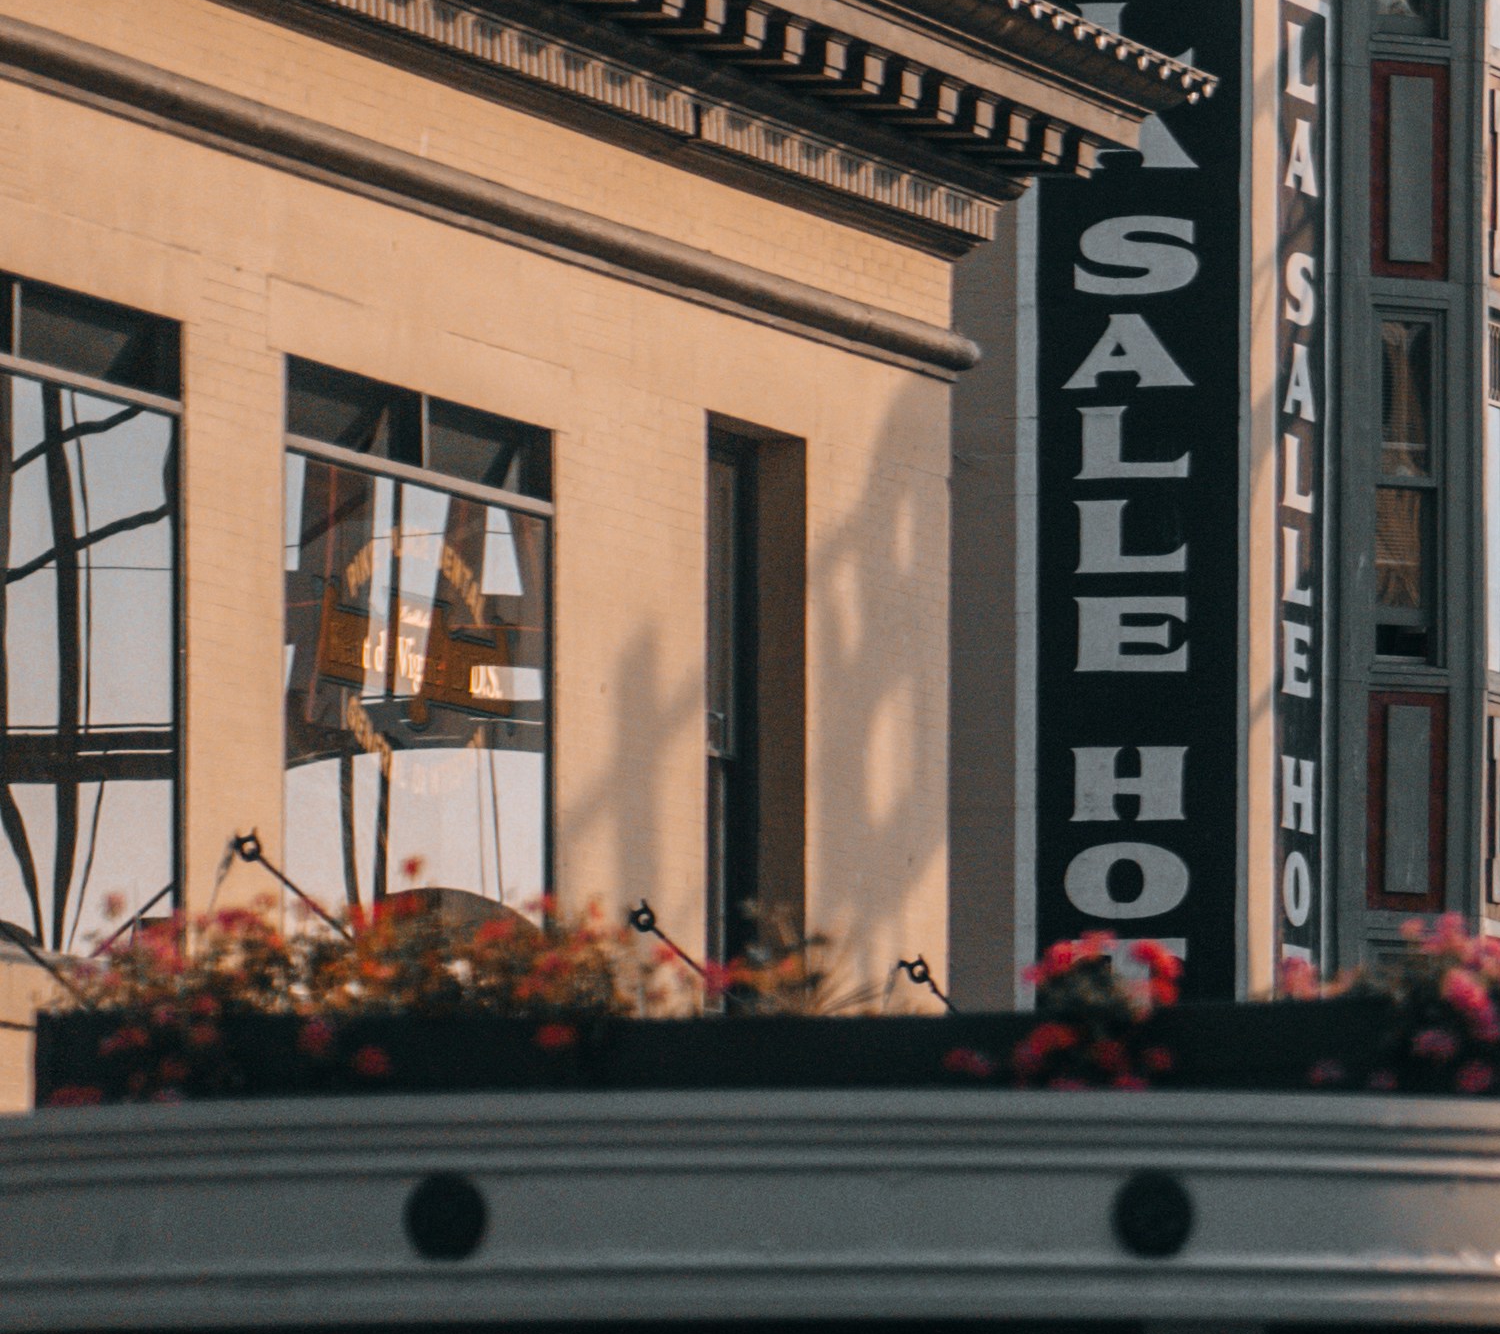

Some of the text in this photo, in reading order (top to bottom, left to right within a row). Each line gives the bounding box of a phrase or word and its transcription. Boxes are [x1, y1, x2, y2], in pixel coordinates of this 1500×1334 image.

[1282, 20, 1318, 198] LA
[1062, 215, 1199, 672] SALLE
[1282, 254, 1317, 699] SALLE
